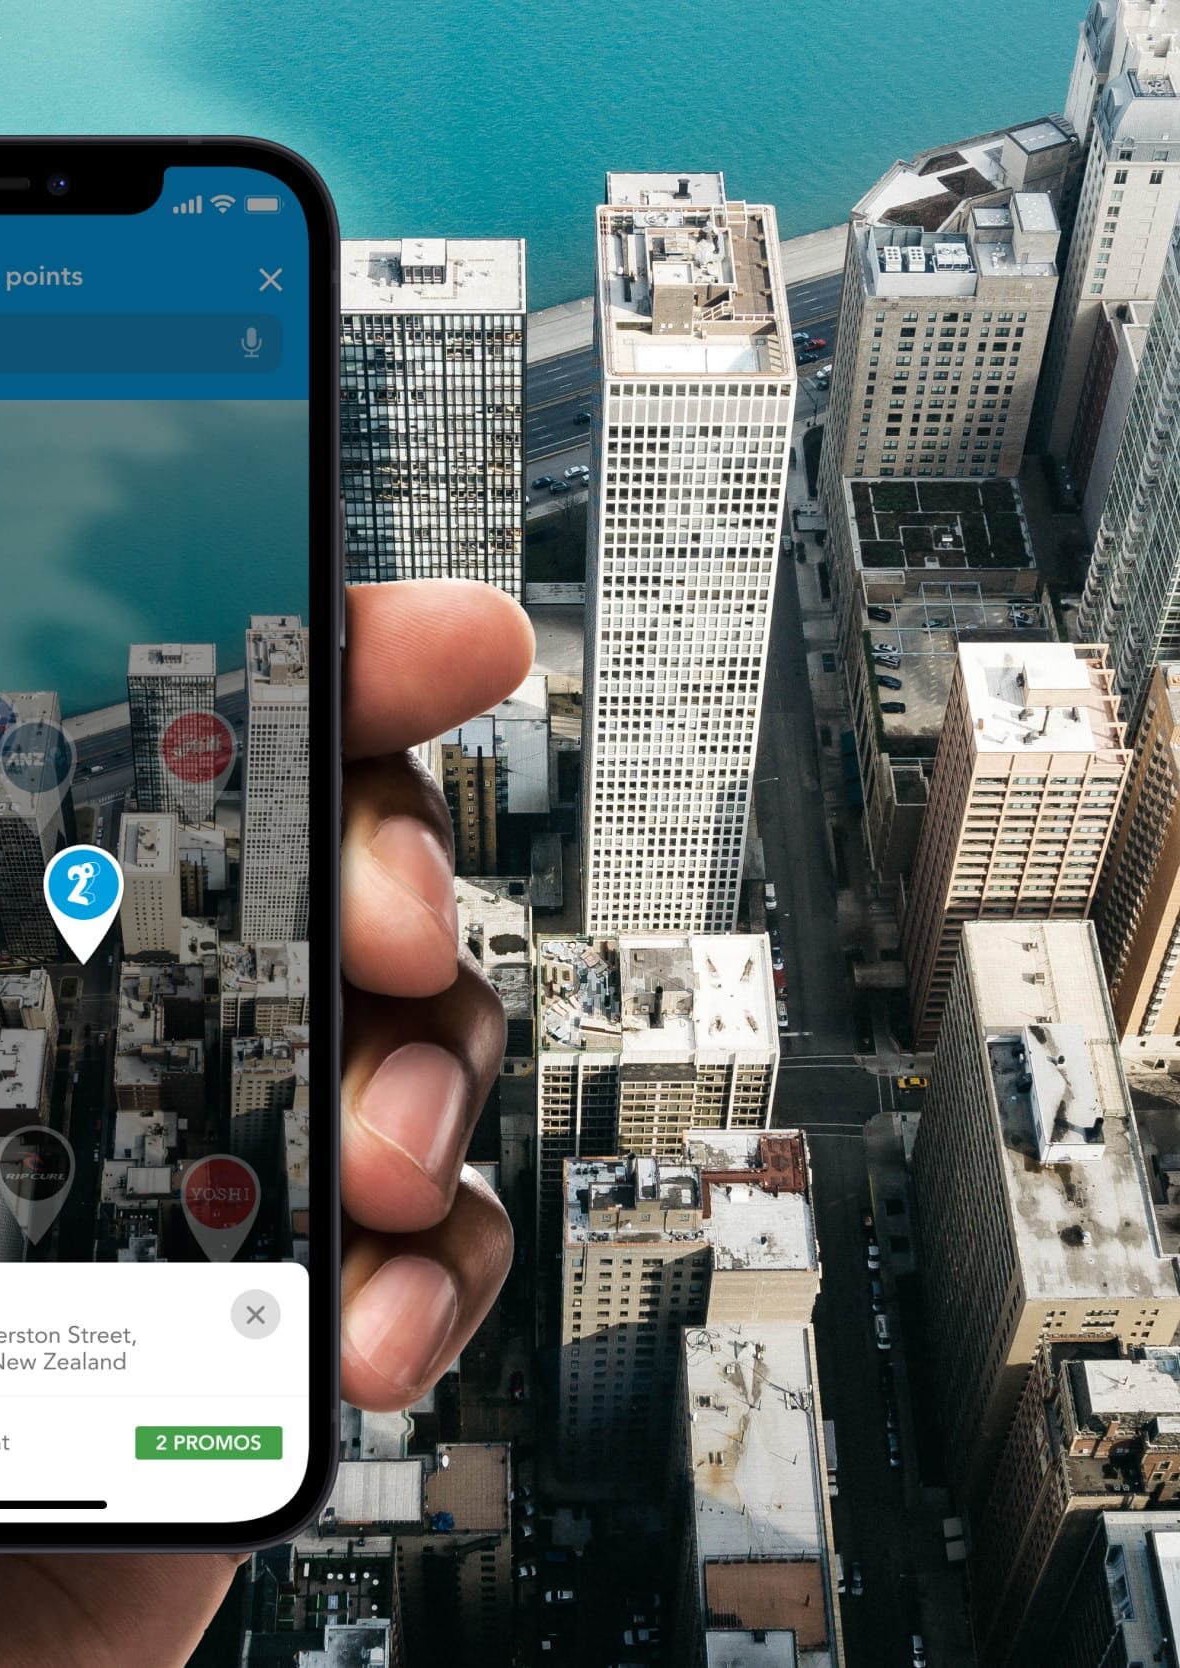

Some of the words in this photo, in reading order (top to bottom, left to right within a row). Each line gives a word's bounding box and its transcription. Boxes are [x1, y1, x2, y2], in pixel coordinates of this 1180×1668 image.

[7, 265, 83, 291] points
[6, 752, 45, 767] ANZ
[191, 1187, 250, 1201] YOSHI
[68, 1325, 137, 1347] Street,
[43, 1352, 127, 1371] Zealand
[156, 1435, 168, 1451] 2
[174, 1434, 262, 1451] PROMOS
